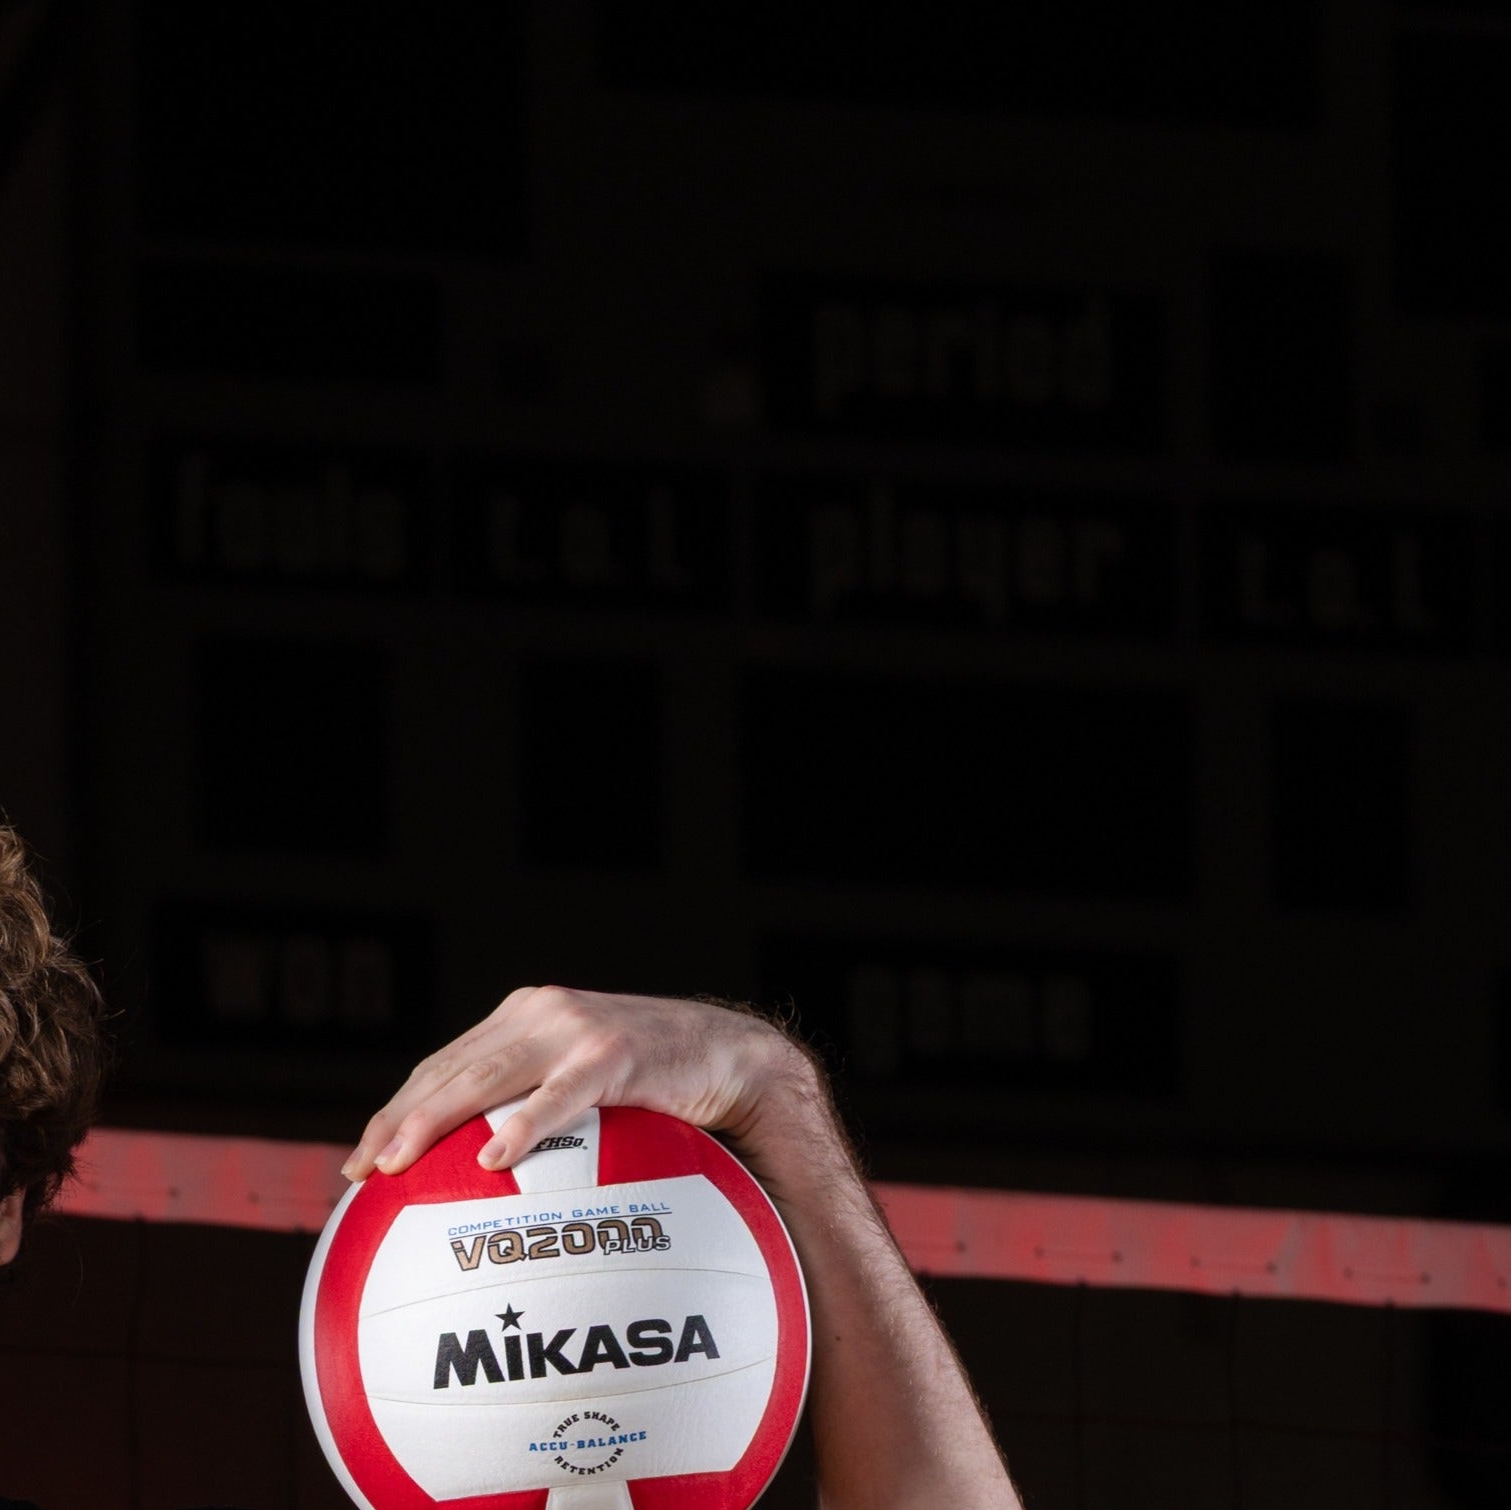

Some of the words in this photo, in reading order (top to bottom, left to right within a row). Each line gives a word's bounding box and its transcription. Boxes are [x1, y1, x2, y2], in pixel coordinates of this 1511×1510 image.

[812, 296, 1112, 412] period
[808, 480, 1128, 628] player
[448, 1211, 563, 1237] COMPETITION
[571, 1204, 621, 1219] GAME
[628, 1201, 672, 1214] BALL
[450, 1216, 664, 1272] VQ2000
[603, 1235, 672, 1256] PLUS
[528, 1430, 647, 1452] ACCU-BALANCE
[553, 1413, 581, 1439] TRUE
[583, 1410, 621, 1432] SHAPE
[553, 1447, 625, 1476] RETENTION
